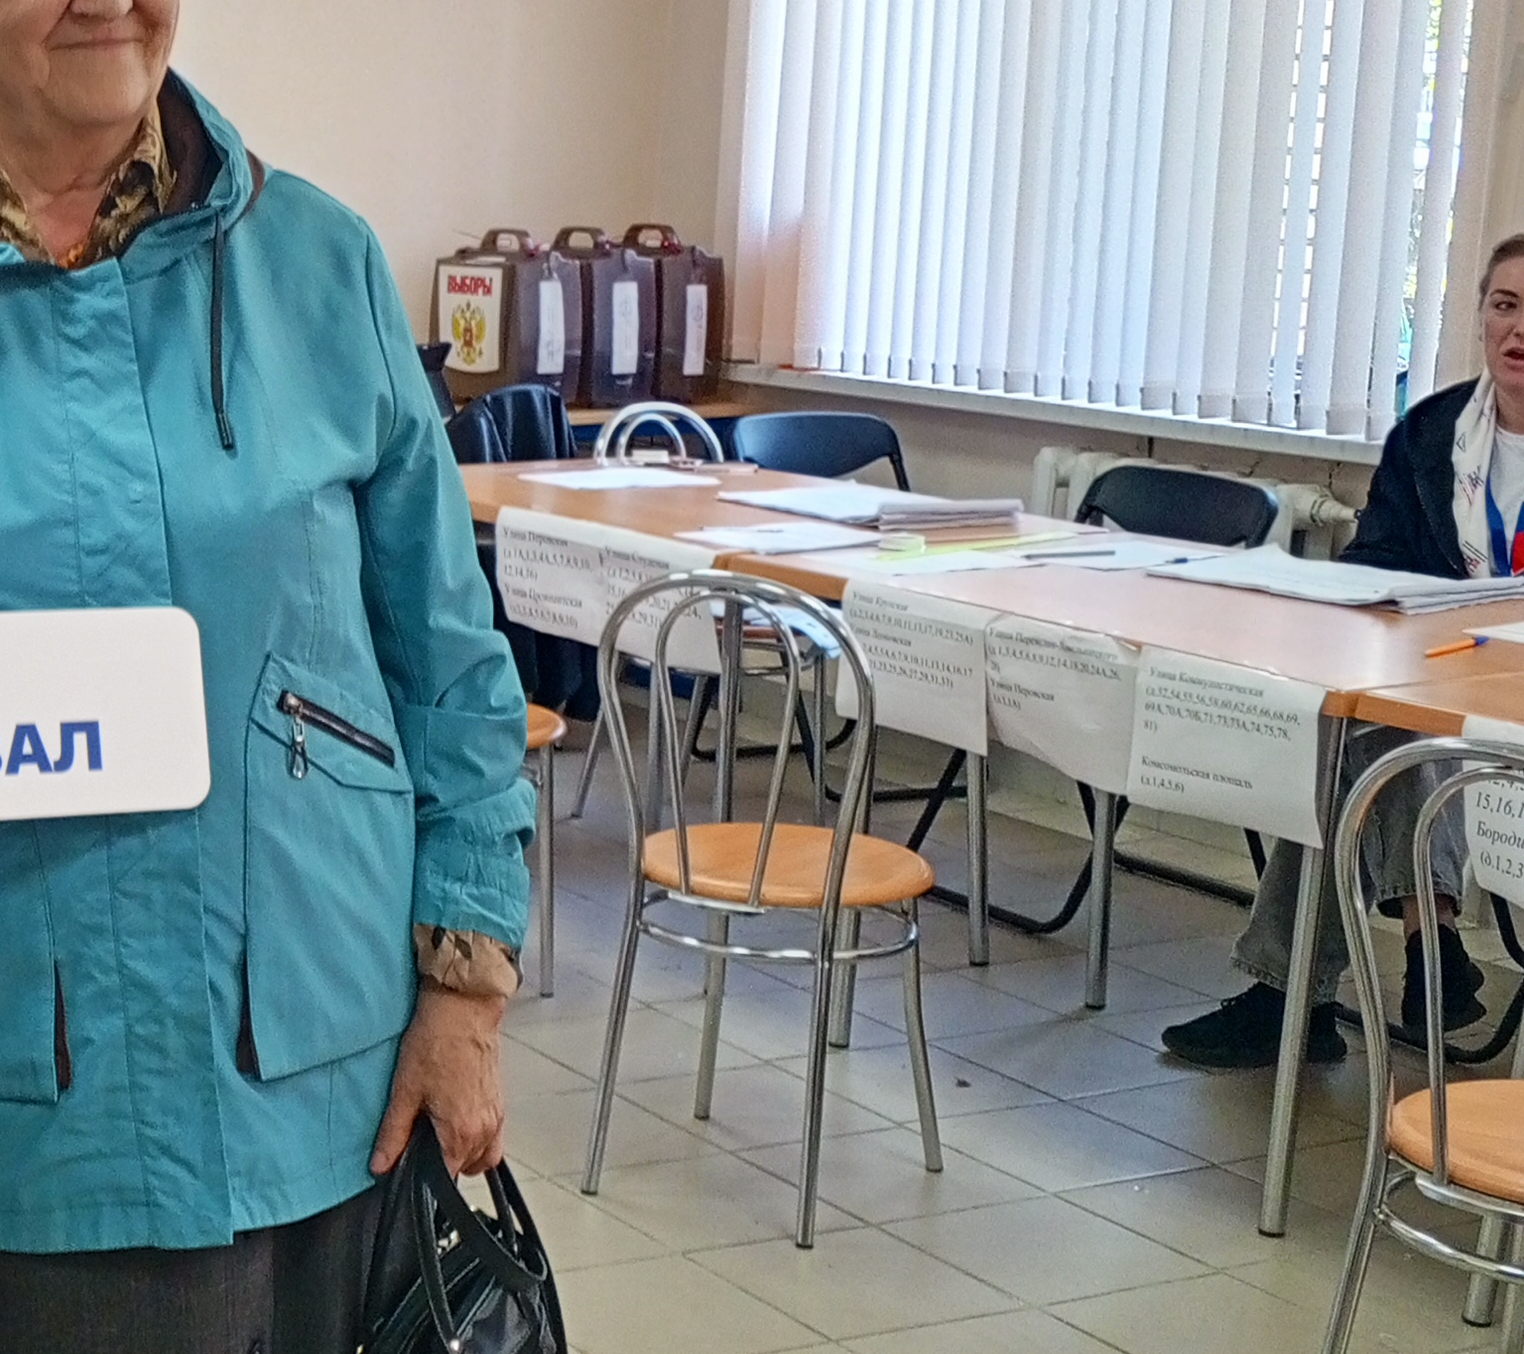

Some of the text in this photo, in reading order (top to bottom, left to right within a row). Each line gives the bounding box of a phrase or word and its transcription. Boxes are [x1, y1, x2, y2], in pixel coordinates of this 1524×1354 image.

[447, 275, 493, 296] ВЫБОРЫ
[1149, 666, 1264, 698] Улица Коммунистическая
[1141, 755, 1253, 790] Комсомольская площадь
